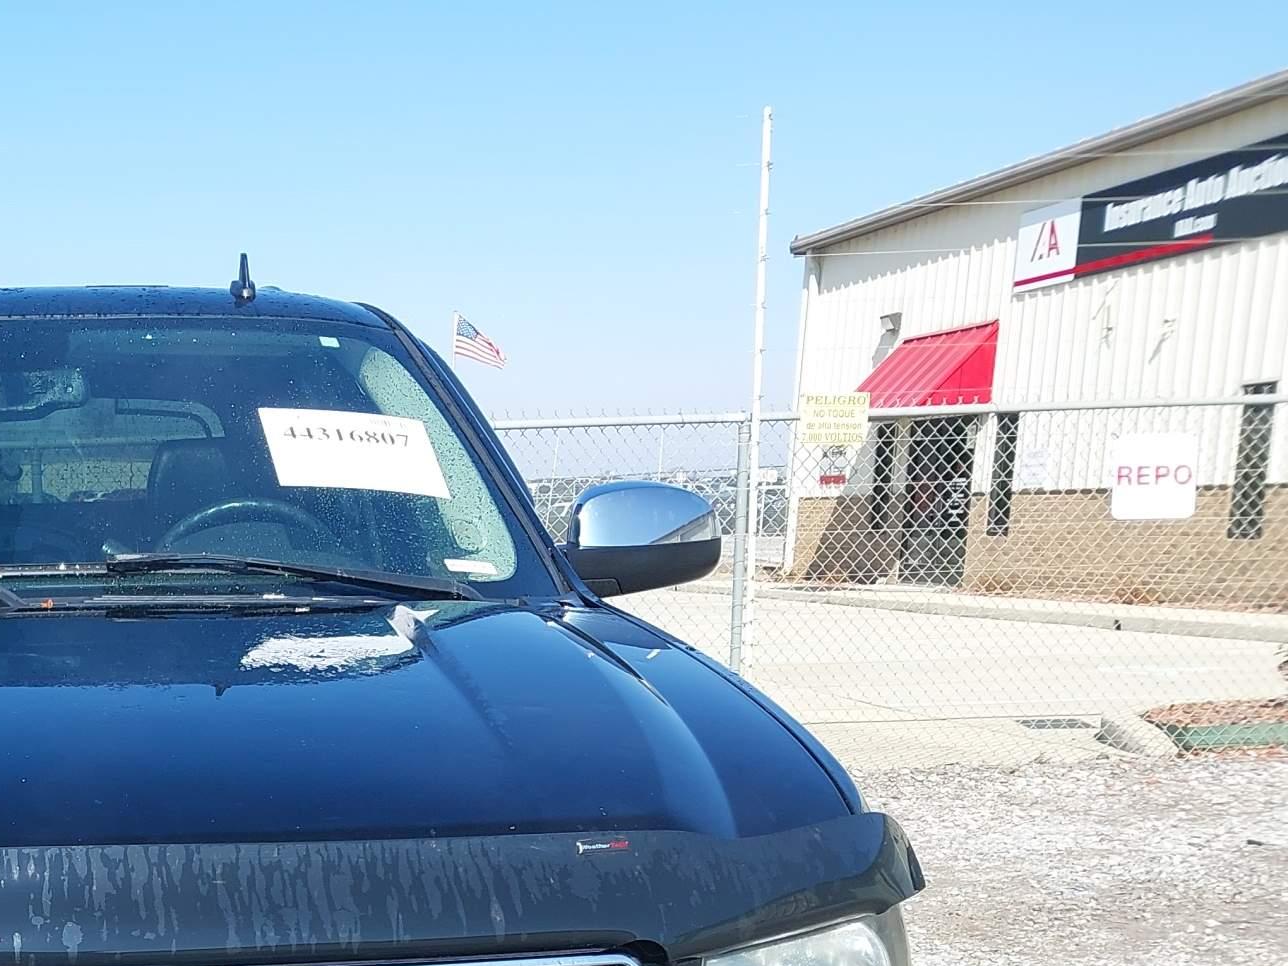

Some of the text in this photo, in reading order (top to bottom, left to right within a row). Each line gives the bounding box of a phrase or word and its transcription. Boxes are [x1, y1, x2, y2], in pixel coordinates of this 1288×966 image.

[1183, 173, 1226, 211] Auto
[806, 395, 866, 406] PELIGRO
[813, 409, 856, 418] NO TOQUE
[283, 426, 409, 447] 44316807
[824, 432, 863, 442] VOLTIOS
[1117, 465, 1192, 486] REPO
